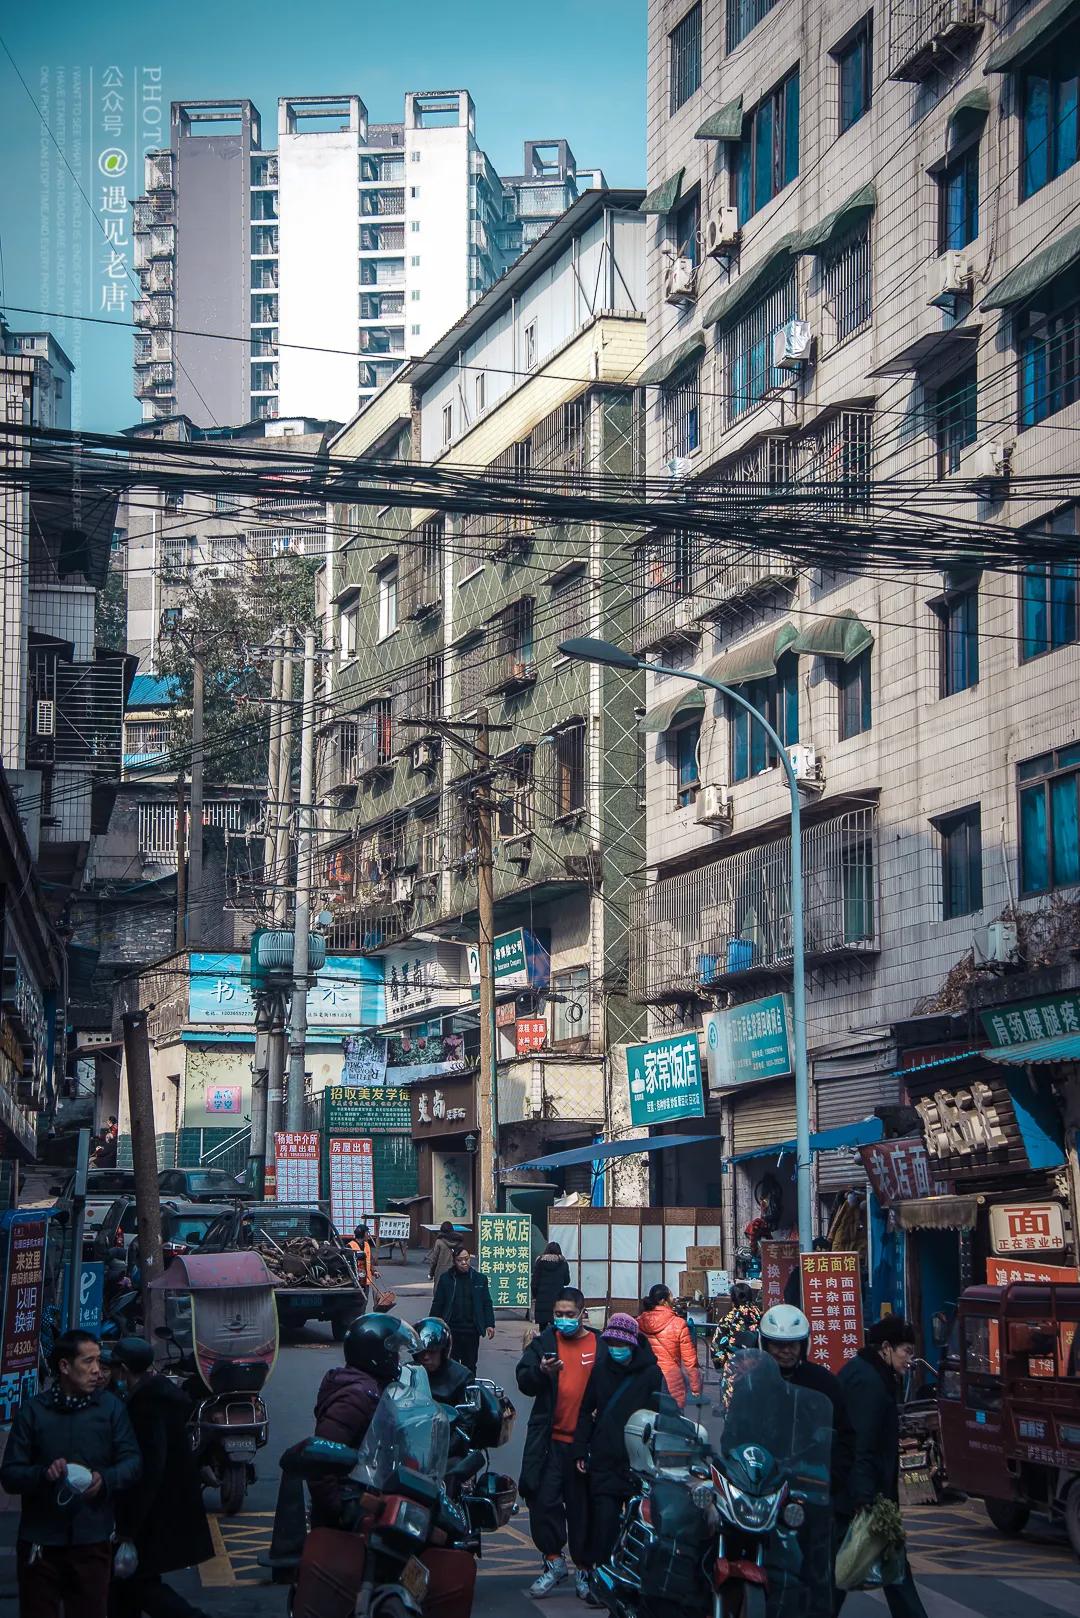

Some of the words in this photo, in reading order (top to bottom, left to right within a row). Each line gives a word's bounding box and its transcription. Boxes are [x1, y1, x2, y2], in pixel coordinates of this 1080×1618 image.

[991, 1000, 1080, 1046] 肩颈腰腿疼
[643, 1040, 698, 1094] 家常饭店
[330, 1087, 411, 1101] 招收美发学徒
[332, 1142, 370, 1153] 房屋出售
[870, 1144, 948, 1200] 老店面
[1003, 1206, 1052, 1237] 面
[481, 1218, 529, 1241] 家常饭店
[998, 1236, 1063, 1249] 正在营业中
[481, 1246, 529, 1258] 各种炒菜
[481, 1261, 529, 1274] 各种炒饭
[803, 1256, 856, 1273] 老店面馆
[809, 1277, 854, 1289] 牛肉面
[810, 1291, 855, 1302] 干杂面
[811, 1305, 856, 1317] 三鲜面
[811, 1319, 857, 1331] 酸菜面
[813, 1334, 858, 1345] 米块
[814, 1347, 858, 1359] 米线
